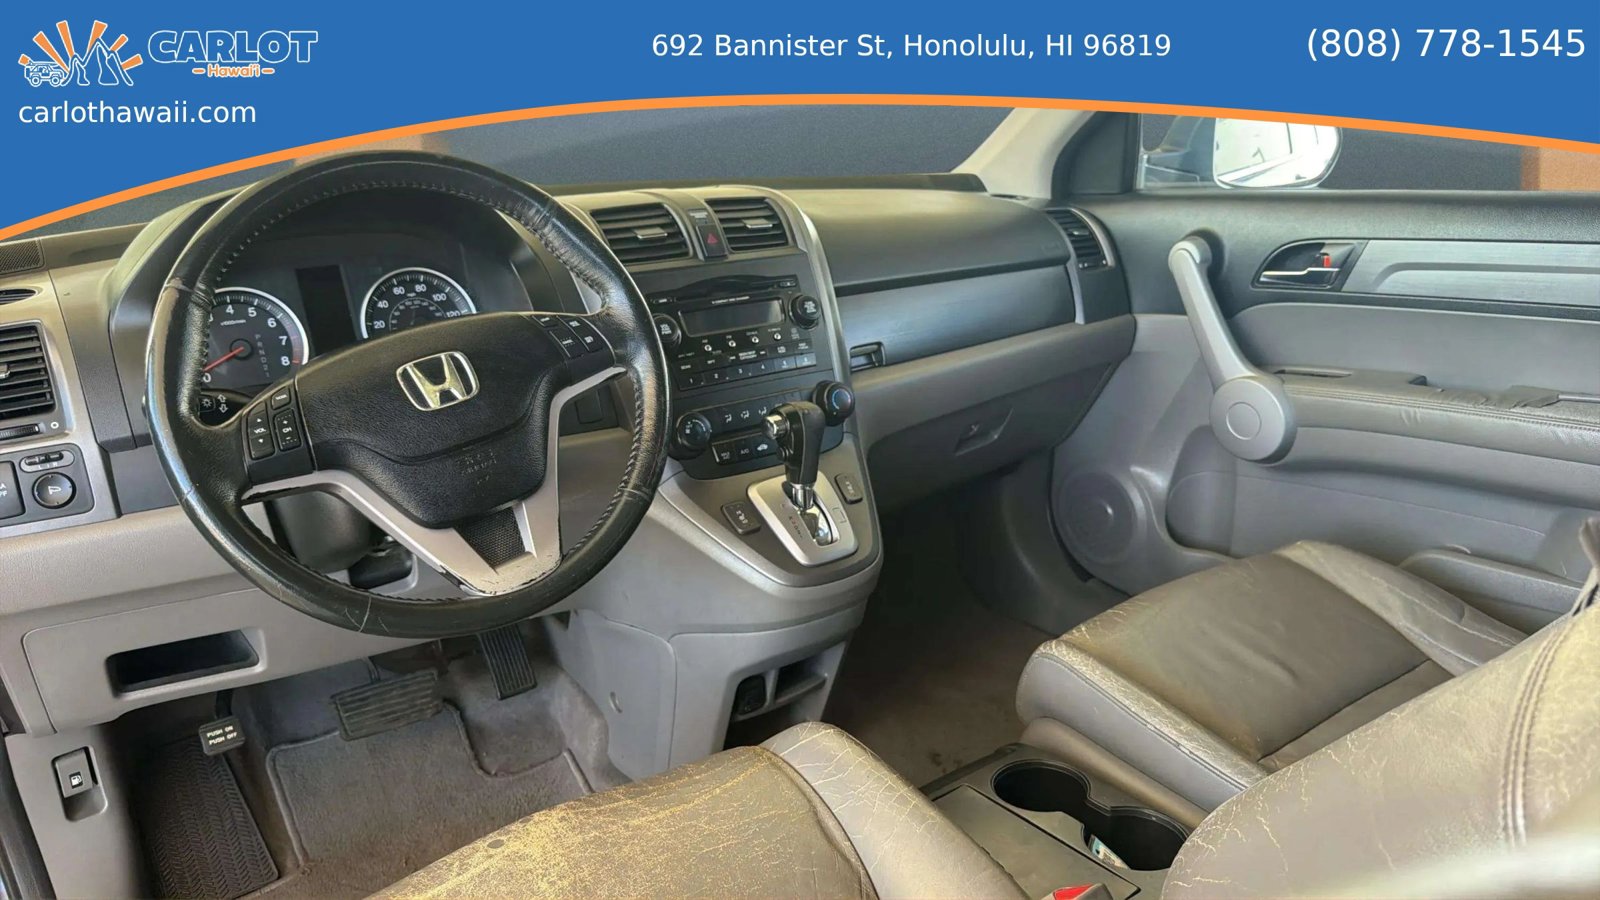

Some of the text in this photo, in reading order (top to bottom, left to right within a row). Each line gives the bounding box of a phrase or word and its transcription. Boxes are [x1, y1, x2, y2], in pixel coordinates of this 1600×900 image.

[393, 286, 405, 295] 60
[415, 284, 427, 293] 80
[432, 293, 447, 302] 100
[377, 300, 389, 309] 40
[225, 305, 234, 315] 4
[248, 307, 257, 317] 5
[267, 318, 277, 328] 6
[373, 321, 386, 329] 20
[278, 335, 288, 346] 7
[281, 356, 290, 366] 8
[206, 728, 223, 738] PUSH
[209, 731, 238, 746] PUSH OFF
